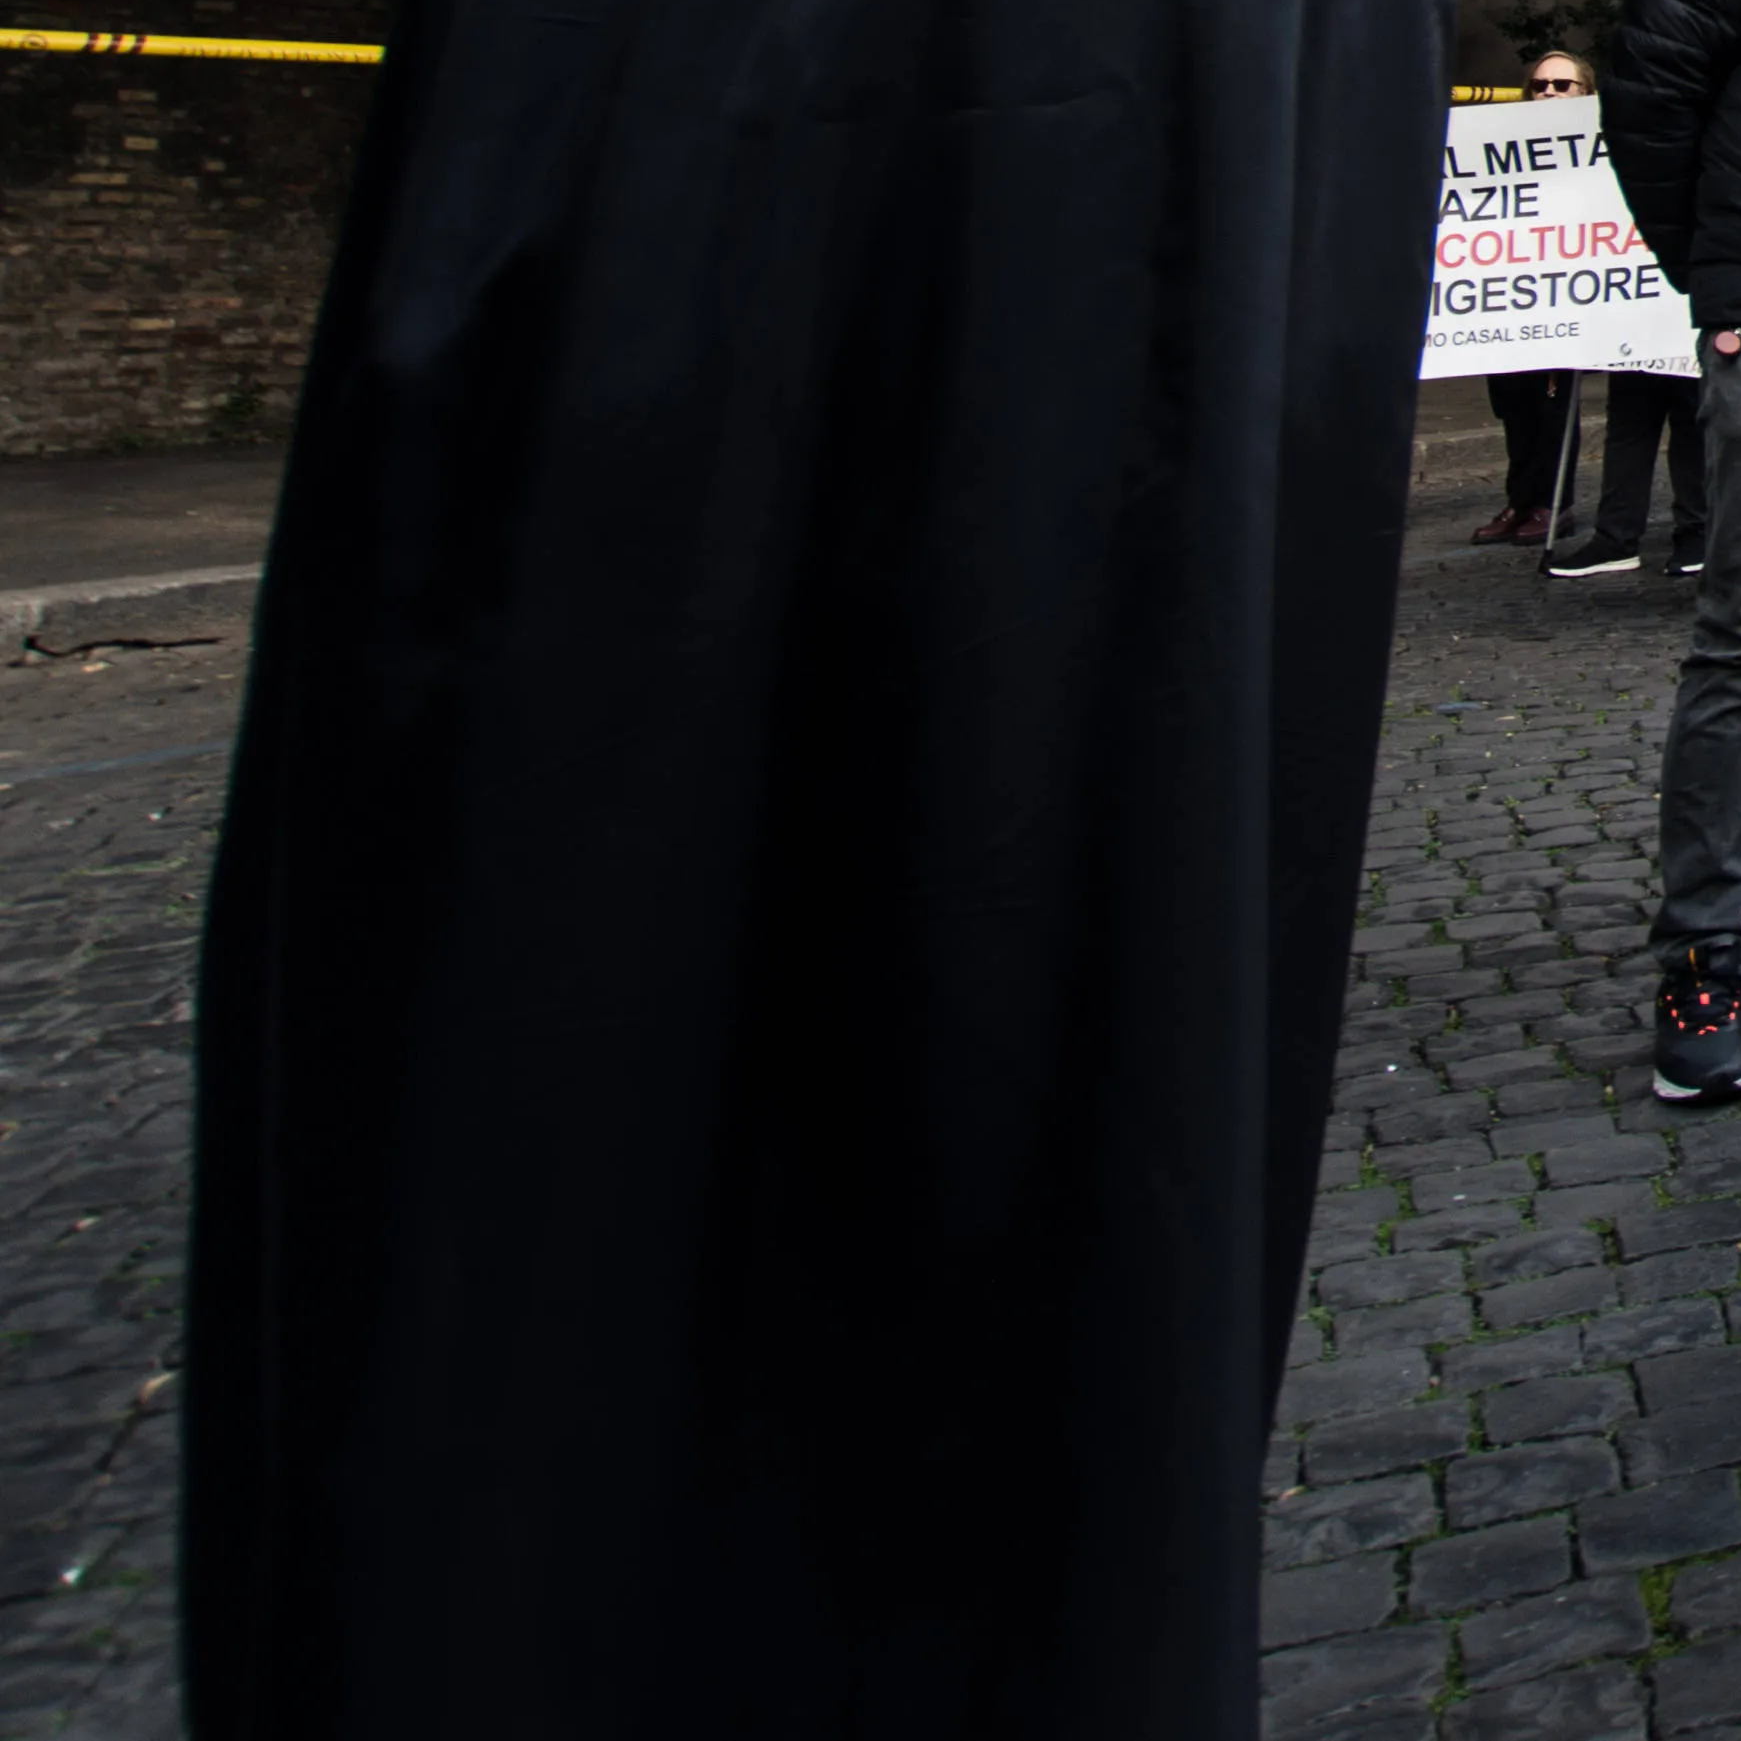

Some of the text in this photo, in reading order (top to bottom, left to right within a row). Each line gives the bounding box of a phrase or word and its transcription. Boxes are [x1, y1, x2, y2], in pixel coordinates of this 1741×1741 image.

[1436, 221, 1651, 268] COLTURA
[1432, 263, 1661, 316] IGESTORE
[1452, 328, 1514, 347] CASAL
[1519, 322, 1580, 342] SELCE
